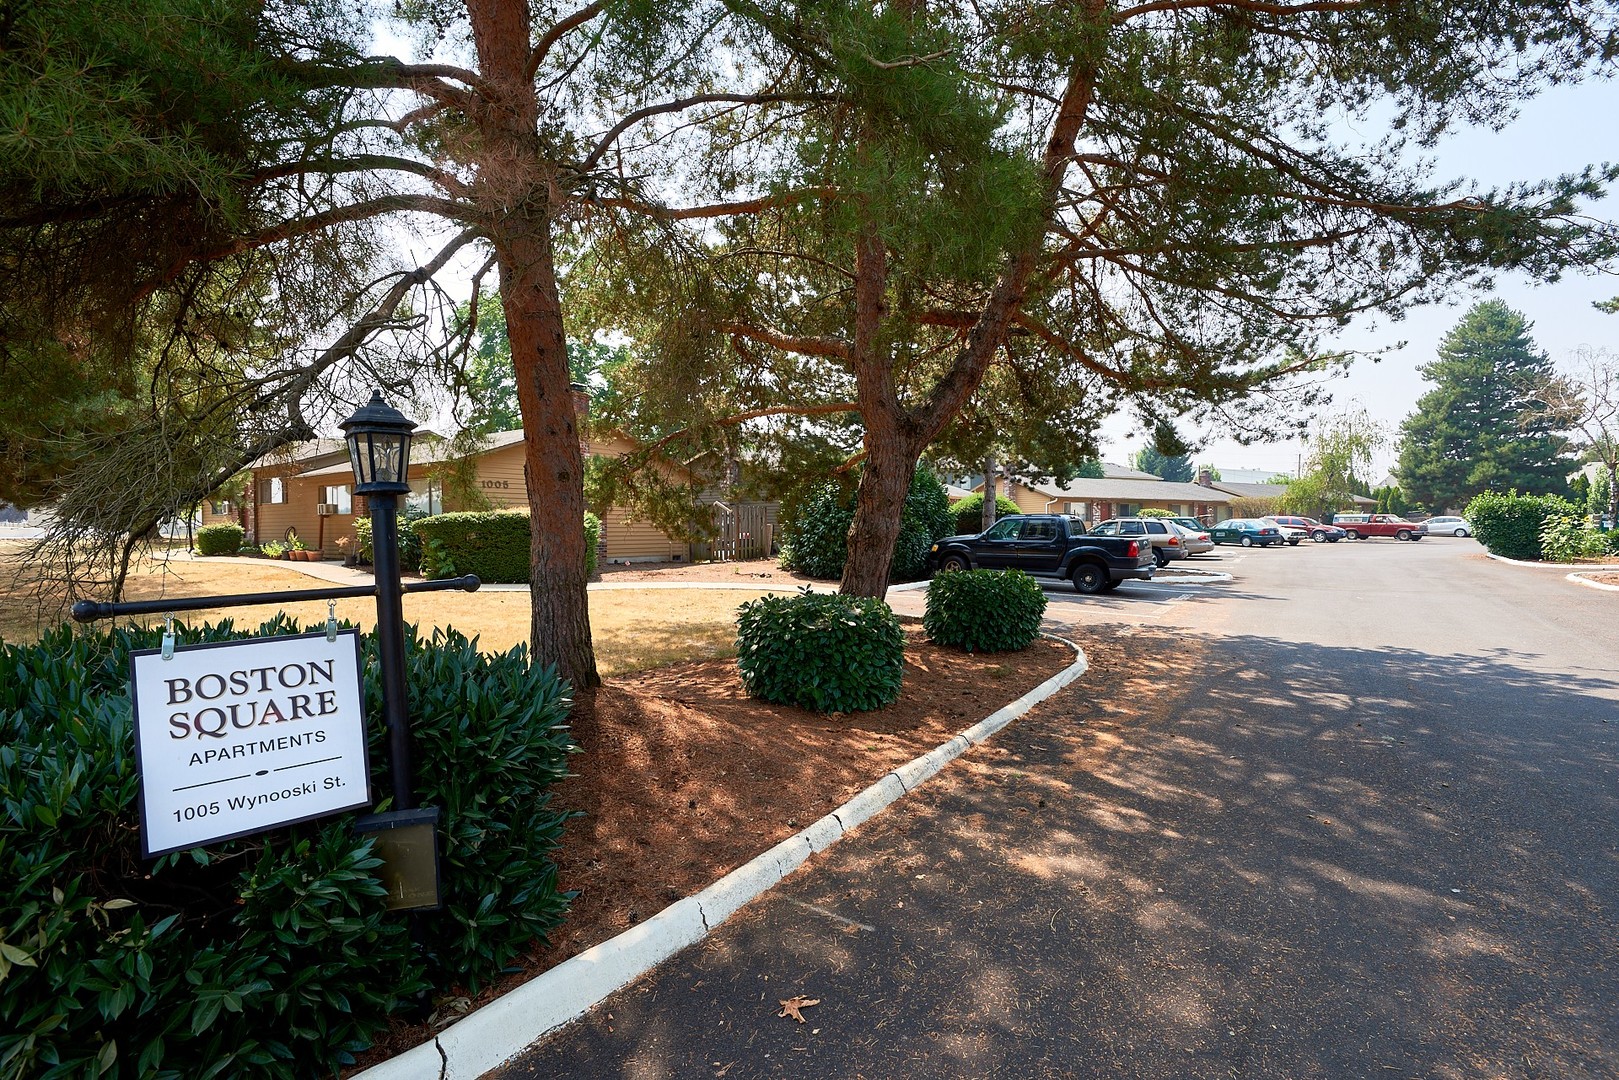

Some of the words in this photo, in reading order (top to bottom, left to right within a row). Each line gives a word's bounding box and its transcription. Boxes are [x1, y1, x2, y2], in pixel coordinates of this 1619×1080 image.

[482, 480, 509, 489] 1005
[164, 659, 335, 706] BOSTON
[169, 690, 338, 739] SQUARE
[189, 731, 326, 766] APARTMENTS
[173, 802, 220, 822] 1005
[227, 781, 316, 811] Wynooski
[323, 776, 346, 789] St.
